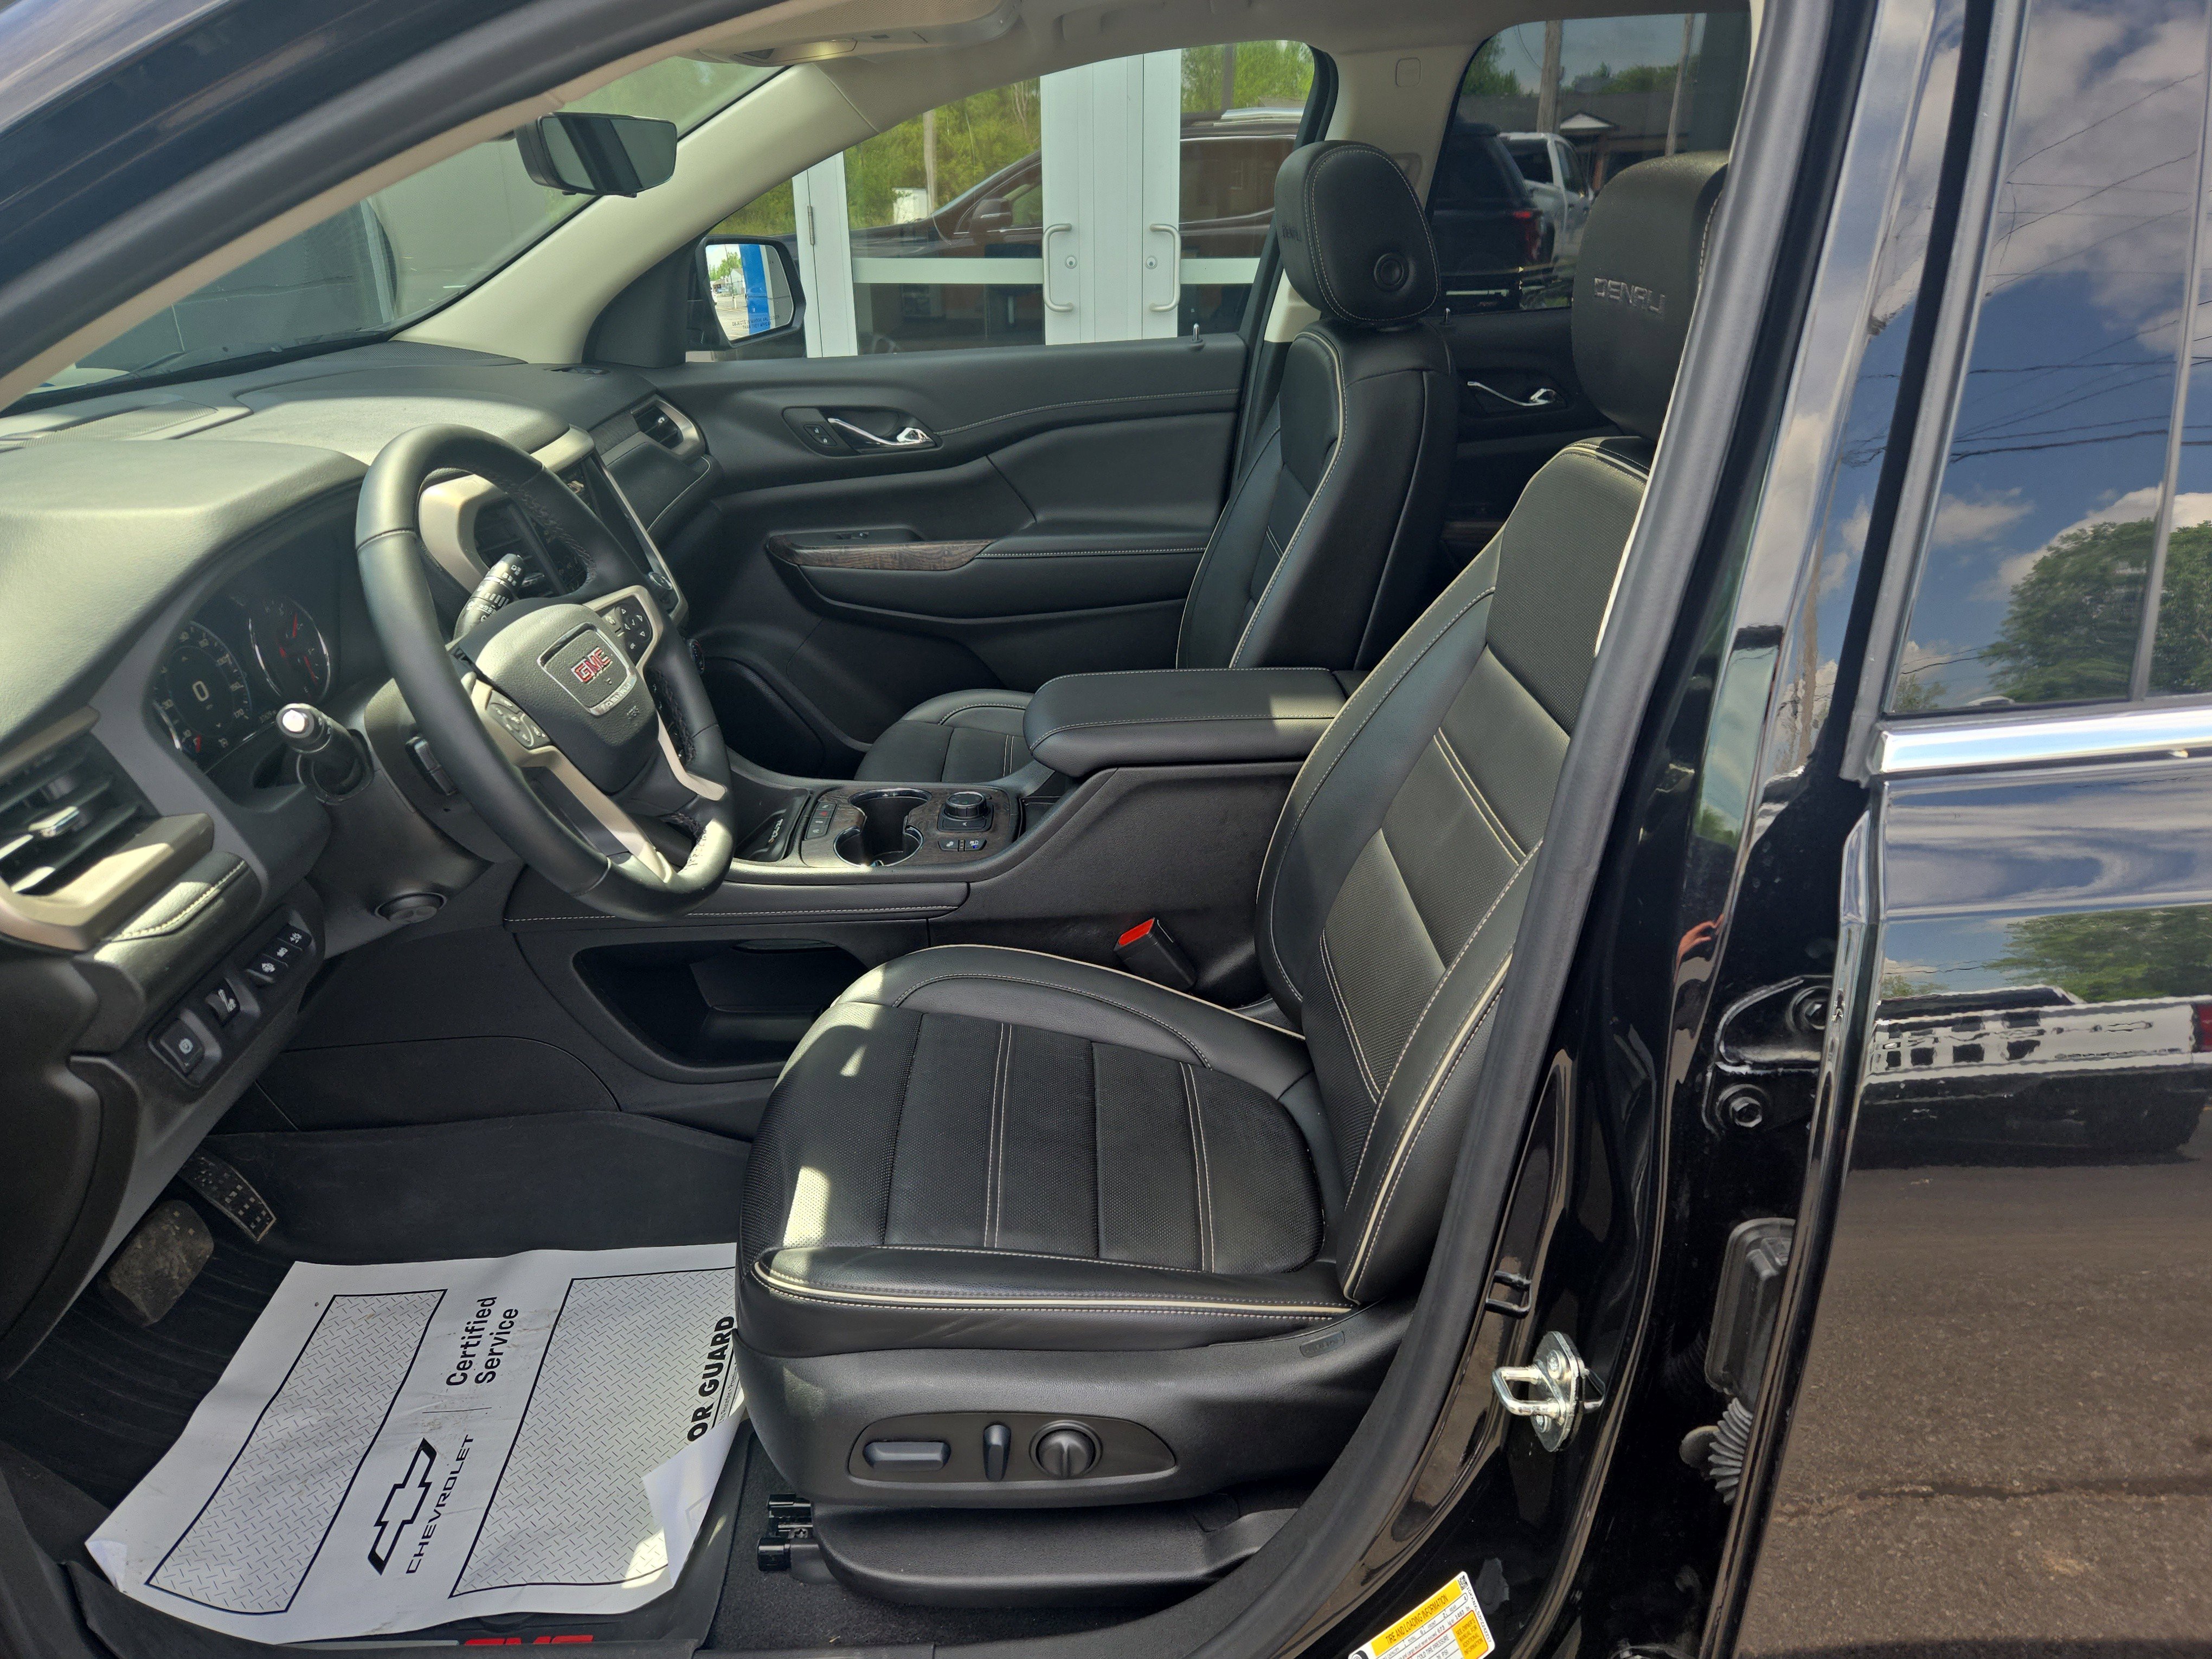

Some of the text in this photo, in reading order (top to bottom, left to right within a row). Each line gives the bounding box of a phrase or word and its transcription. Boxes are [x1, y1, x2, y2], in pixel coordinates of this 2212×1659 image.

[1594, 277, 1666, 320] DENALI
[571, 646, 613, 685] GMC
[192, 680, 209, 702] 0
[446, 1296, 498, 1386] Certified
[474, 1308, 519, 1384] Service
[698, 1316, 735, 1397] GUARD
[687, 1401, 715, 1442] OR
[406, 1434, 474, 1574] CHEVROLET
[1385, 1594, 1449, 1644] TIRE AND LOADING INFORMATION
